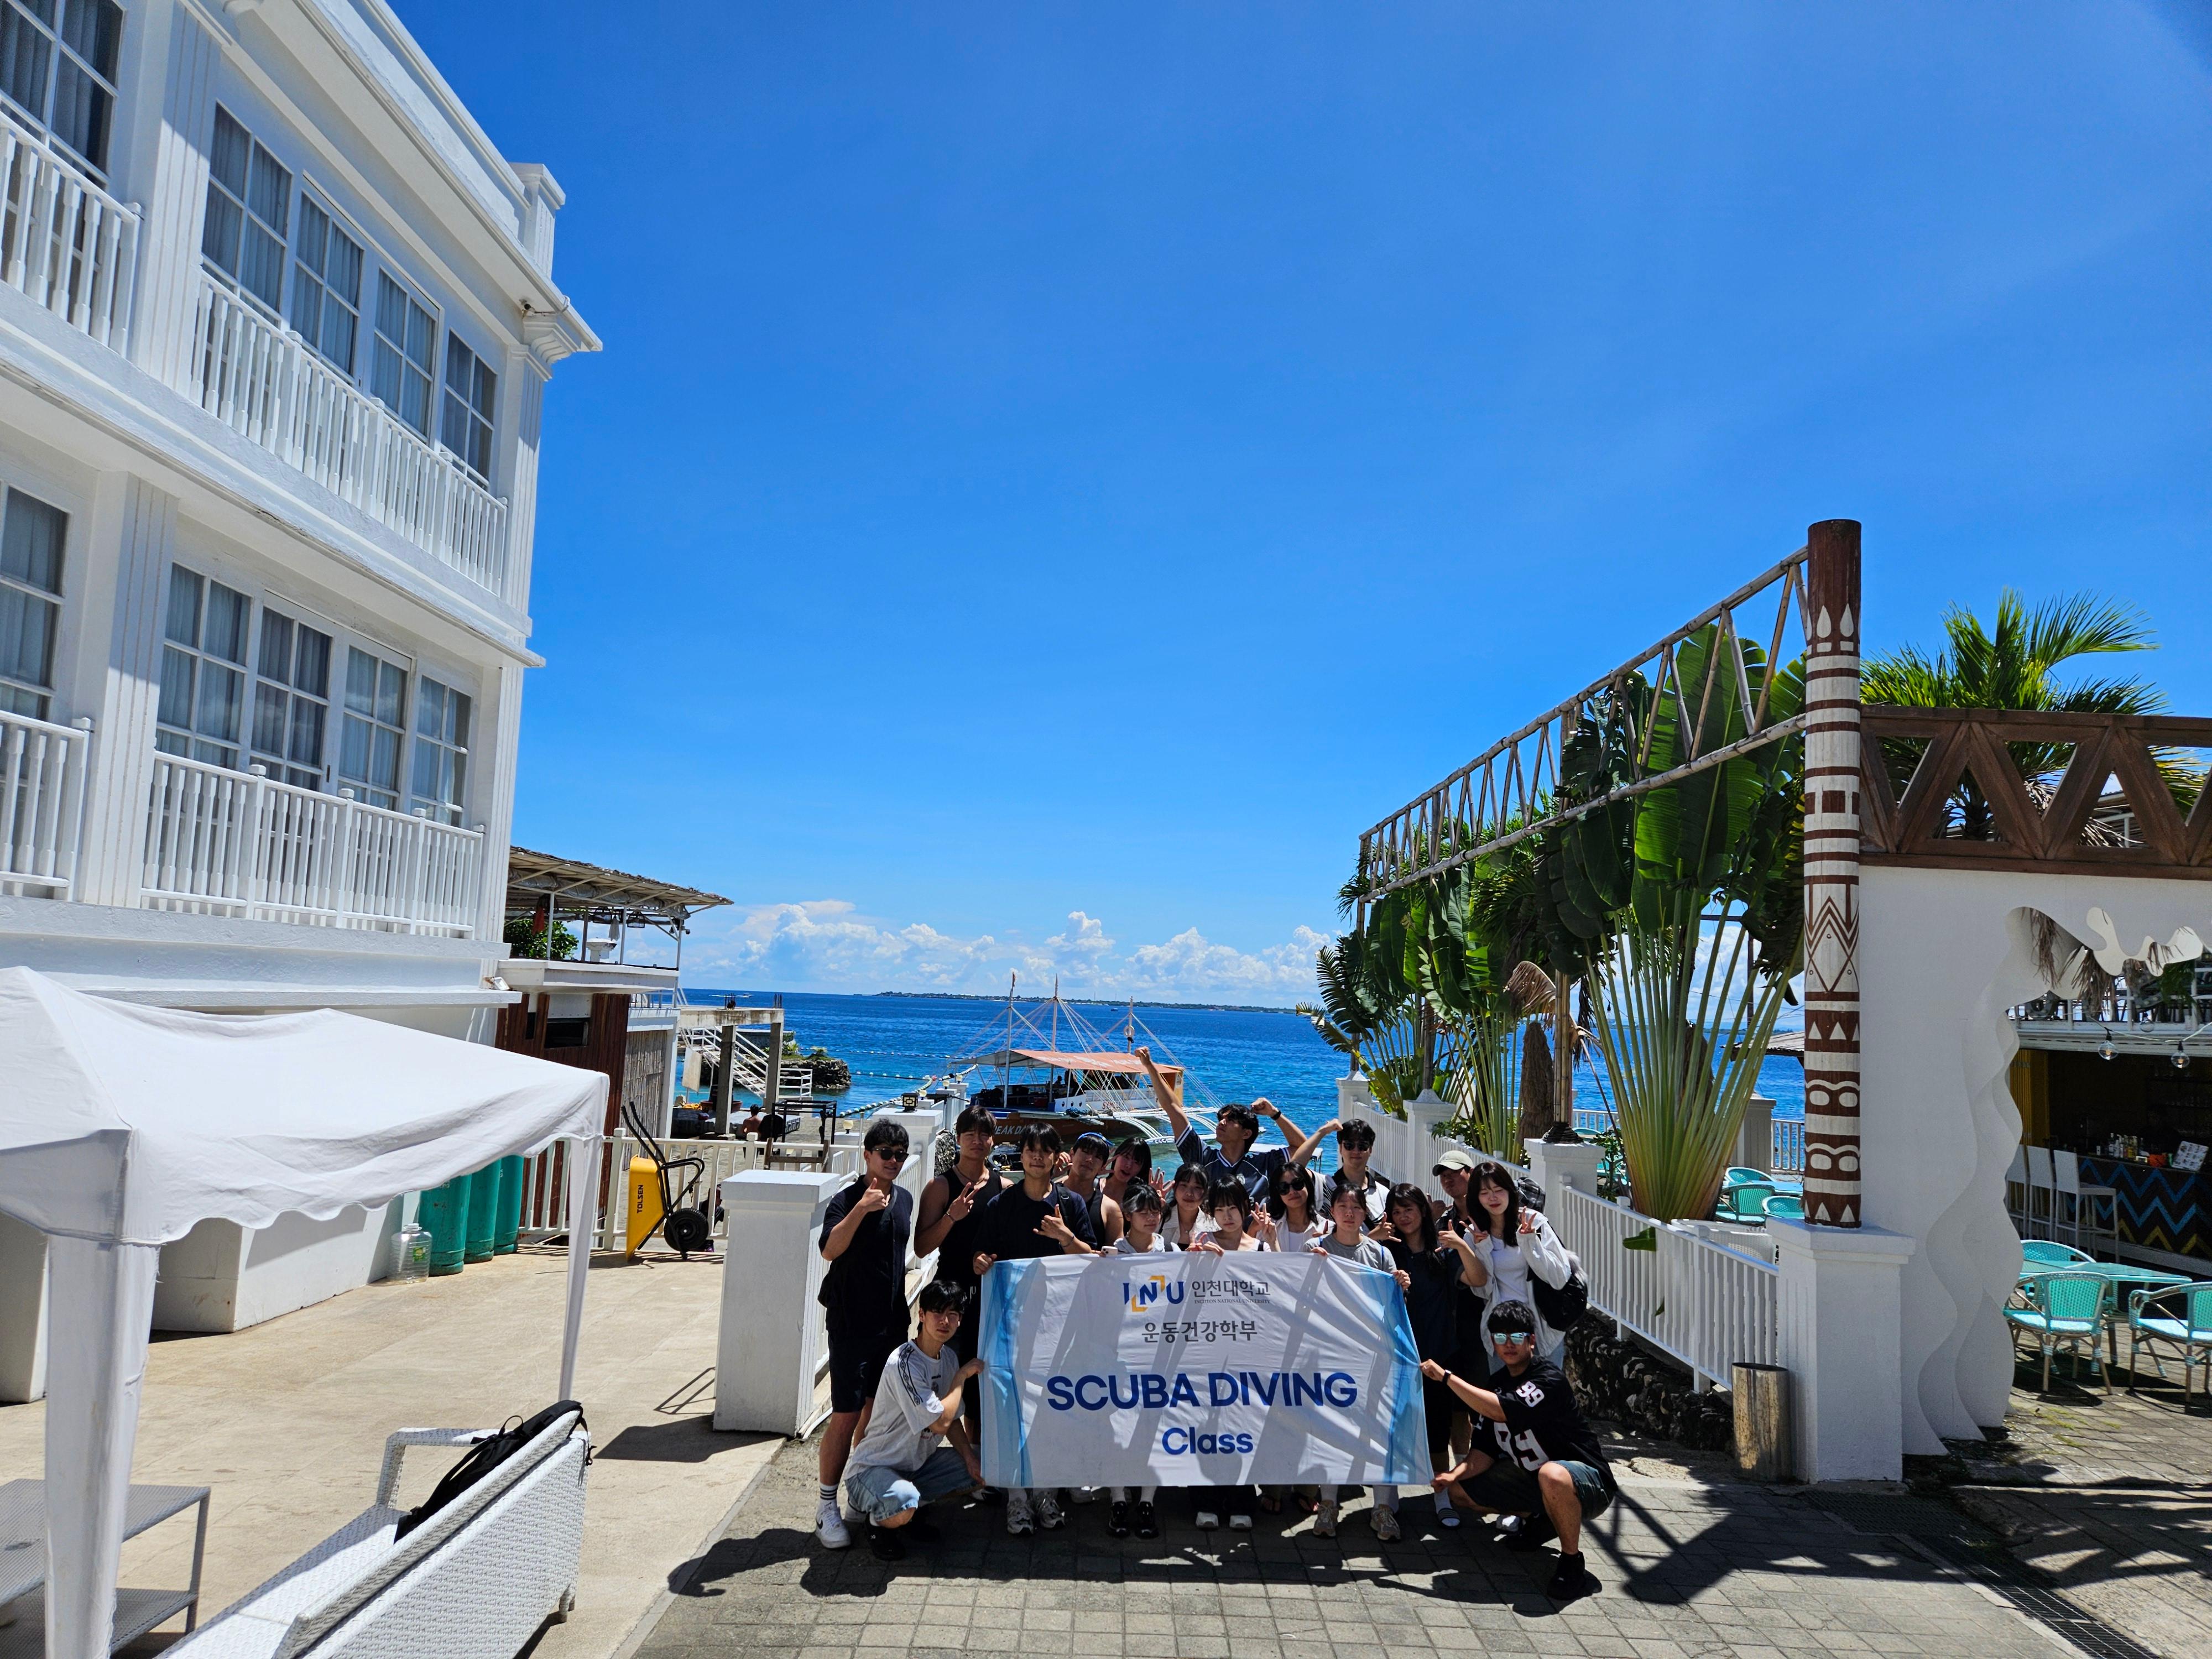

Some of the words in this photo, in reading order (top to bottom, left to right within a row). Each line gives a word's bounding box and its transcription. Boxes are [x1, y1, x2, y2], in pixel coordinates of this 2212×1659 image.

[1123, 1281, 1185, 1306] INU
[1191, 1280, 1271, 1298] 인천대학교
[1141, 1320, 1258, 1344] 운동건강학부
[1047, 1373, 1199, 1411] SCUBA
[1209, 1371, 1358, 1407] DIVING
[1516, 1381, 1545, 1407] 99
[1162, 1427, 1254, 1455] Class
